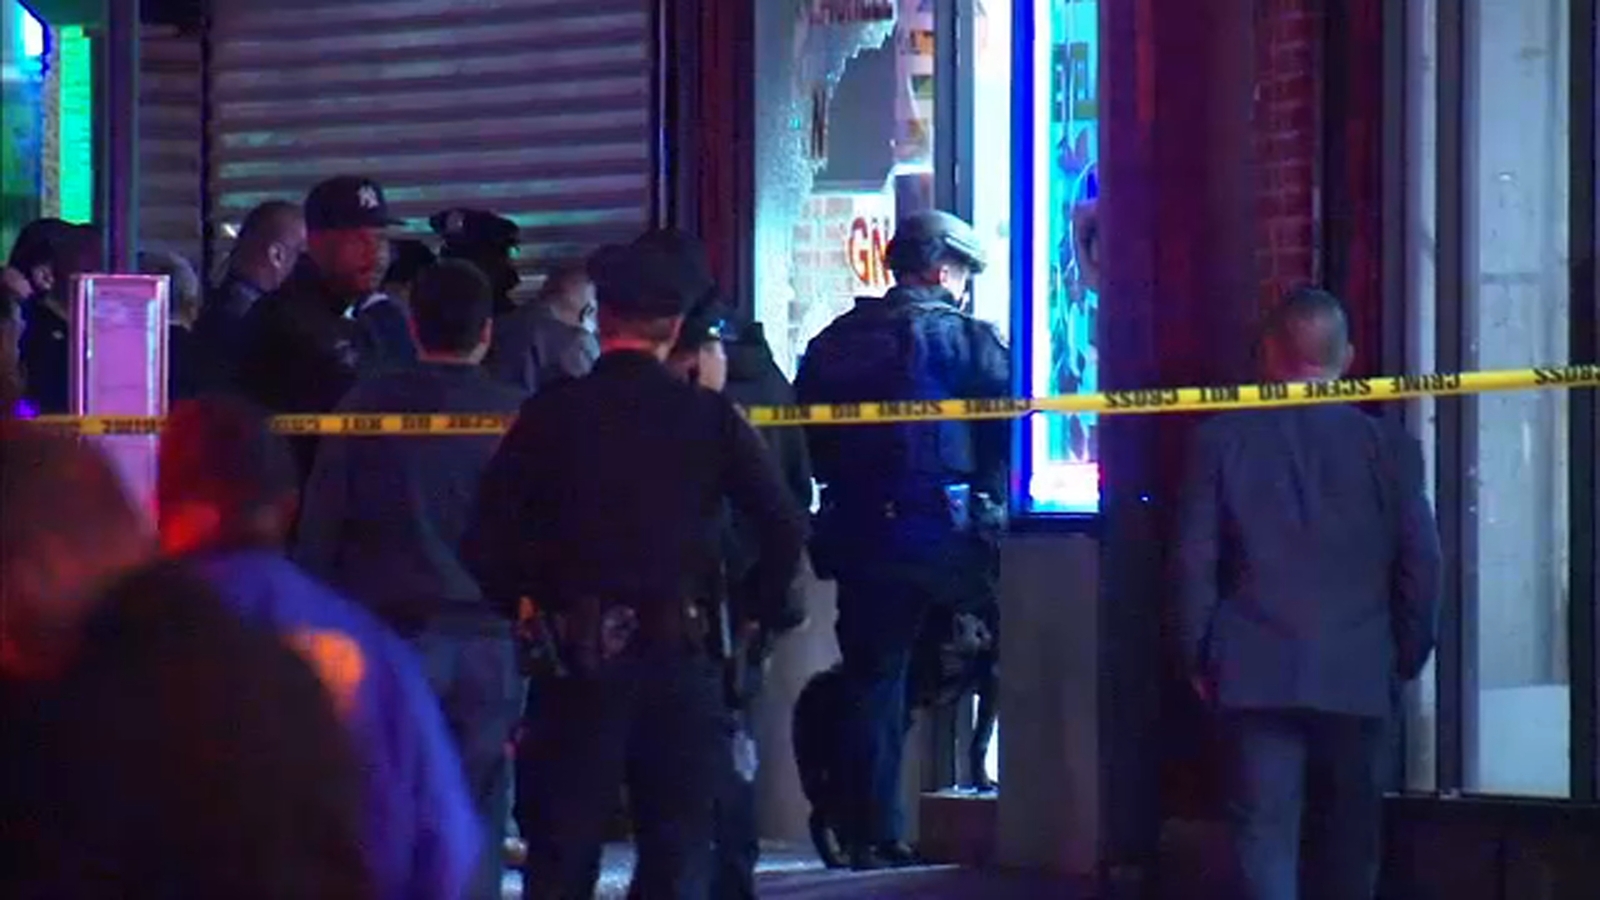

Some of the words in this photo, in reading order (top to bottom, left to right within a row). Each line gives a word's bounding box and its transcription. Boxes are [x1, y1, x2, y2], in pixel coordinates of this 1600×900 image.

[1390, 374, 1460, 394] CRIME
[1533, 365, 1600, 385] ROSS
[1200, 386, 1239, 402] NOT
[1259, 384, 1288, 401] DO
[1303, 378, 1371, 399] SCENE
[1103, 390, 1179, 408] CROSS
[878, 400, 943, 417] SCENE
